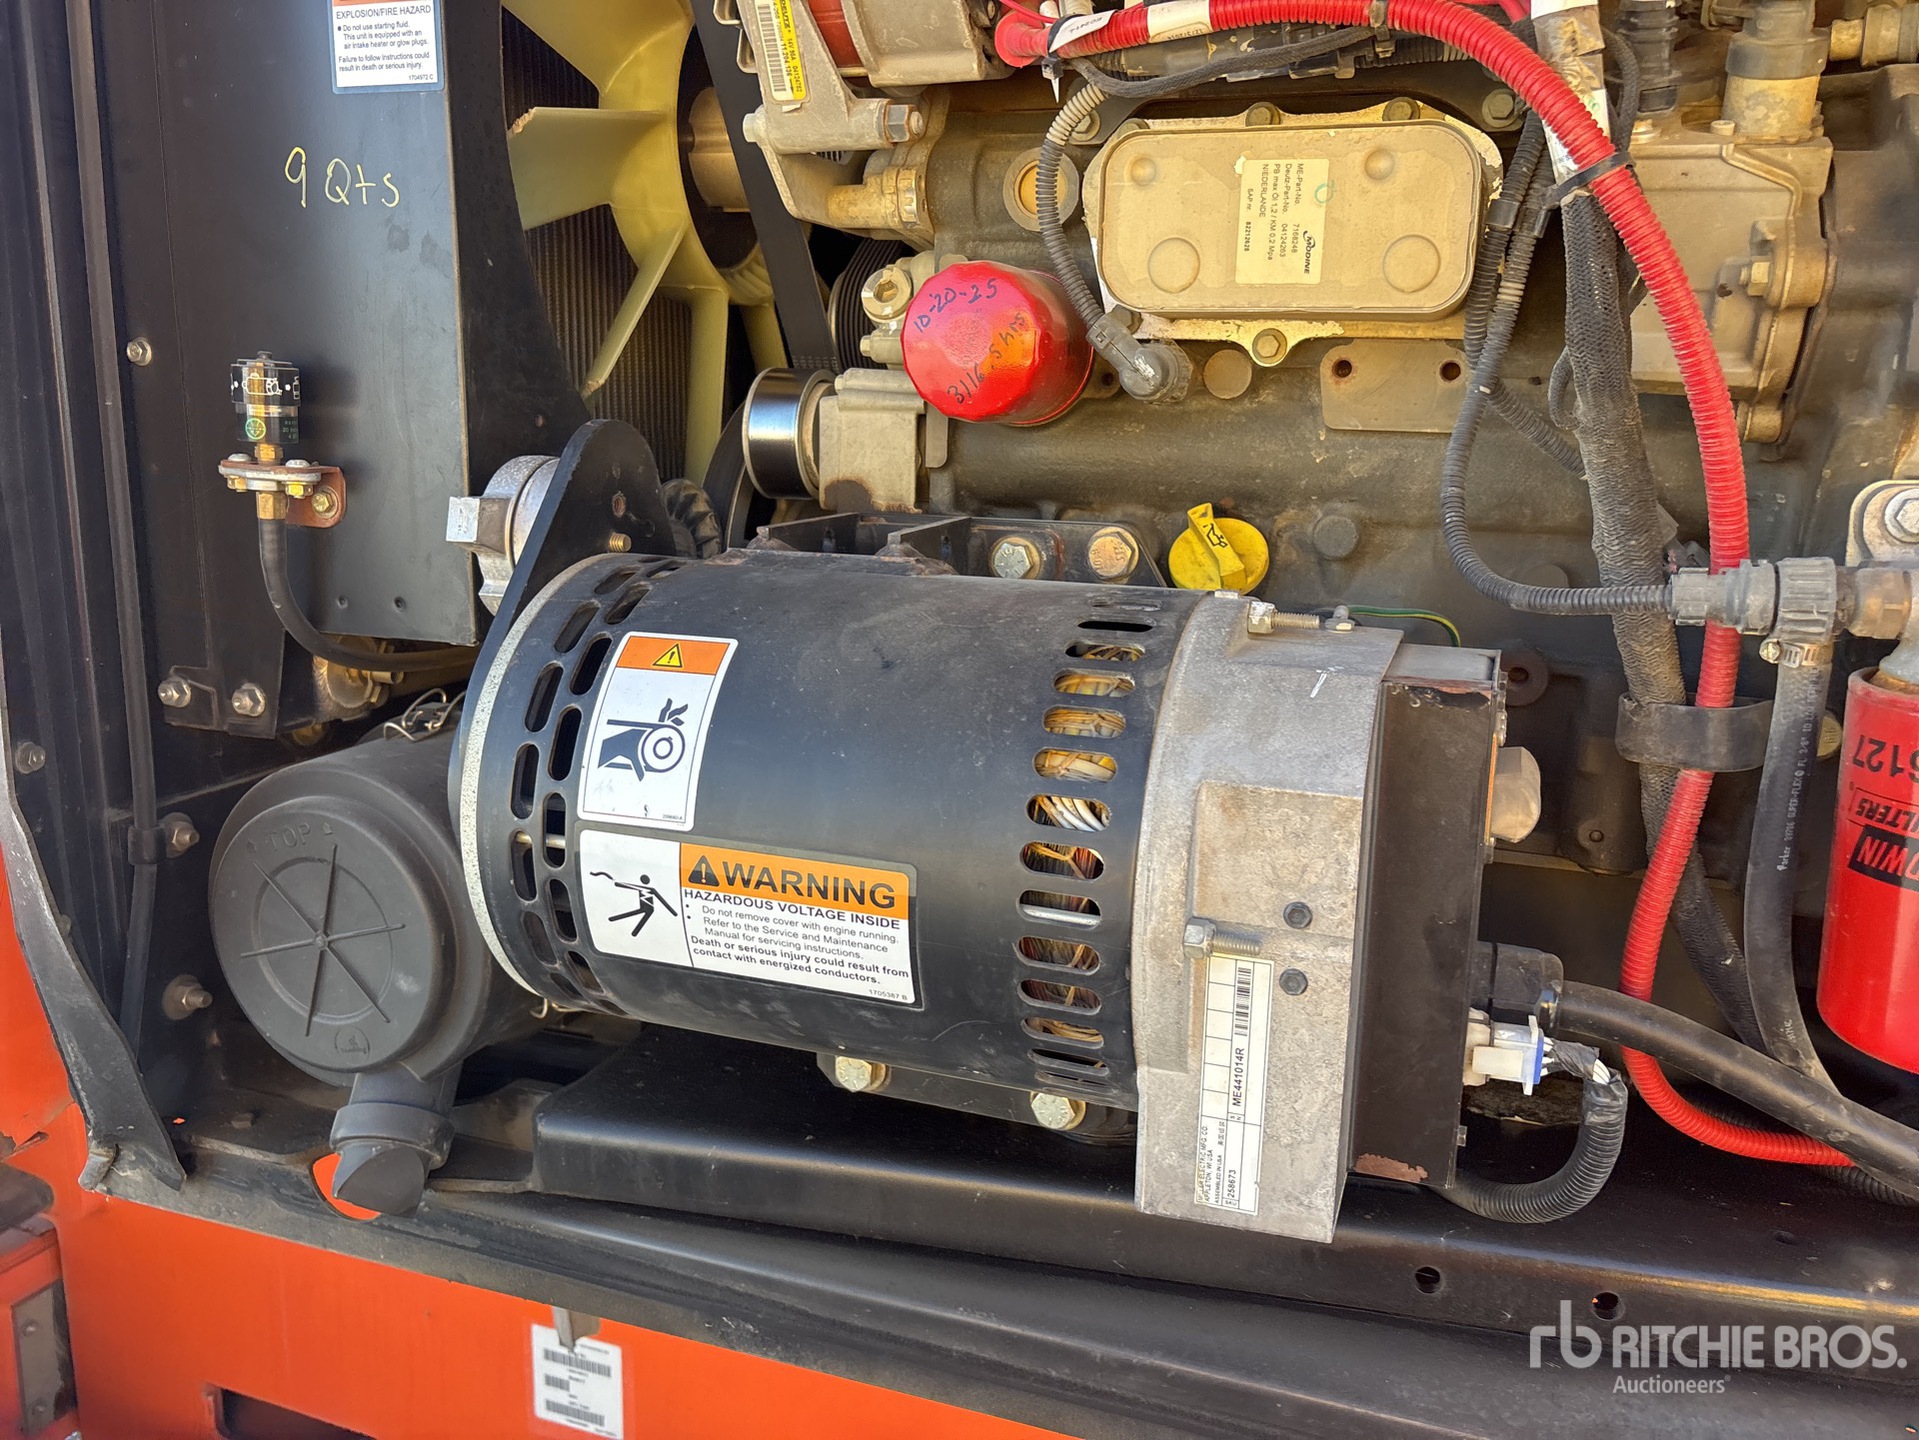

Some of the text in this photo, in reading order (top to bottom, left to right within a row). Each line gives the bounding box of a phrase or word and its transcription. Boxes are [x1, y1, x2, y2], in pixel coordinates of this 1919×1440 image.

[336, 5, 431, 19] EXPLOSION/FIRE HAZARD
[374, 31, 400, 39] equipped
[284, 146, 400, 208] 9 Qts
[1259, 164, 1268, 218] NIEDERLANDE
[1282, 164, 1292, 214] Deutz-Part-No.
[1295, 163, 1304, 206] ME-Part-No.
[1270, 220, 1277, 232] KM
[1304, 234, 1313, 274] MODINE
[914, 278, 998, 333] 10-20-25
[1856, 798, 1919, 836] ILTERS
[265, 822, 311, 852] TOP
[722, 860, 896, 909] WARNING
[684, 888, 900, 930] HAZARDOUS VOLTAGE INSIDE
[702, 905, 899, 944] Do not remove cover with engine running.
[704, 916, 888, 952] Refer to the Service and Maintenance
[704, 928, 864, 960] Manual for servicing instructions.
[691, 936, 909, 978] Death or serious injury could result from
[693, 948, 882, 984] contact with energized conductors.
[1232, 1048, 1244, 1106] ME441014R
[1227, 1169, 1236, 1198] 258673
